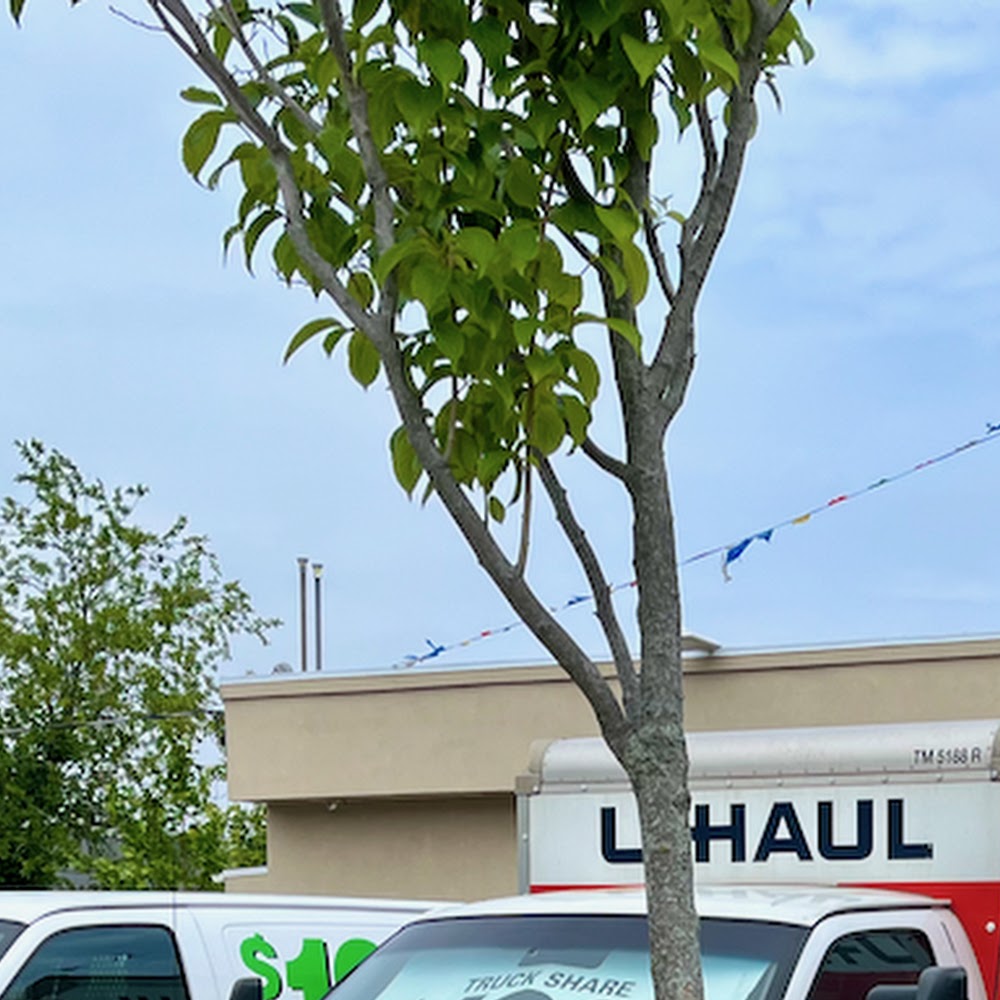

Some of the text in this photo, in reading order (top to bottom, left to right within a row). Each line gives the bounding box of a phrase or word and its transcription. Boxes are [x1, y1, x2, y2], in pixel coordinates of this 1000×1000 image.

[914, 749, 935, 764] TM
[601, 799, 933, 863] UHAUL
[464, 971, 637, 999] TRUCK SHARE
